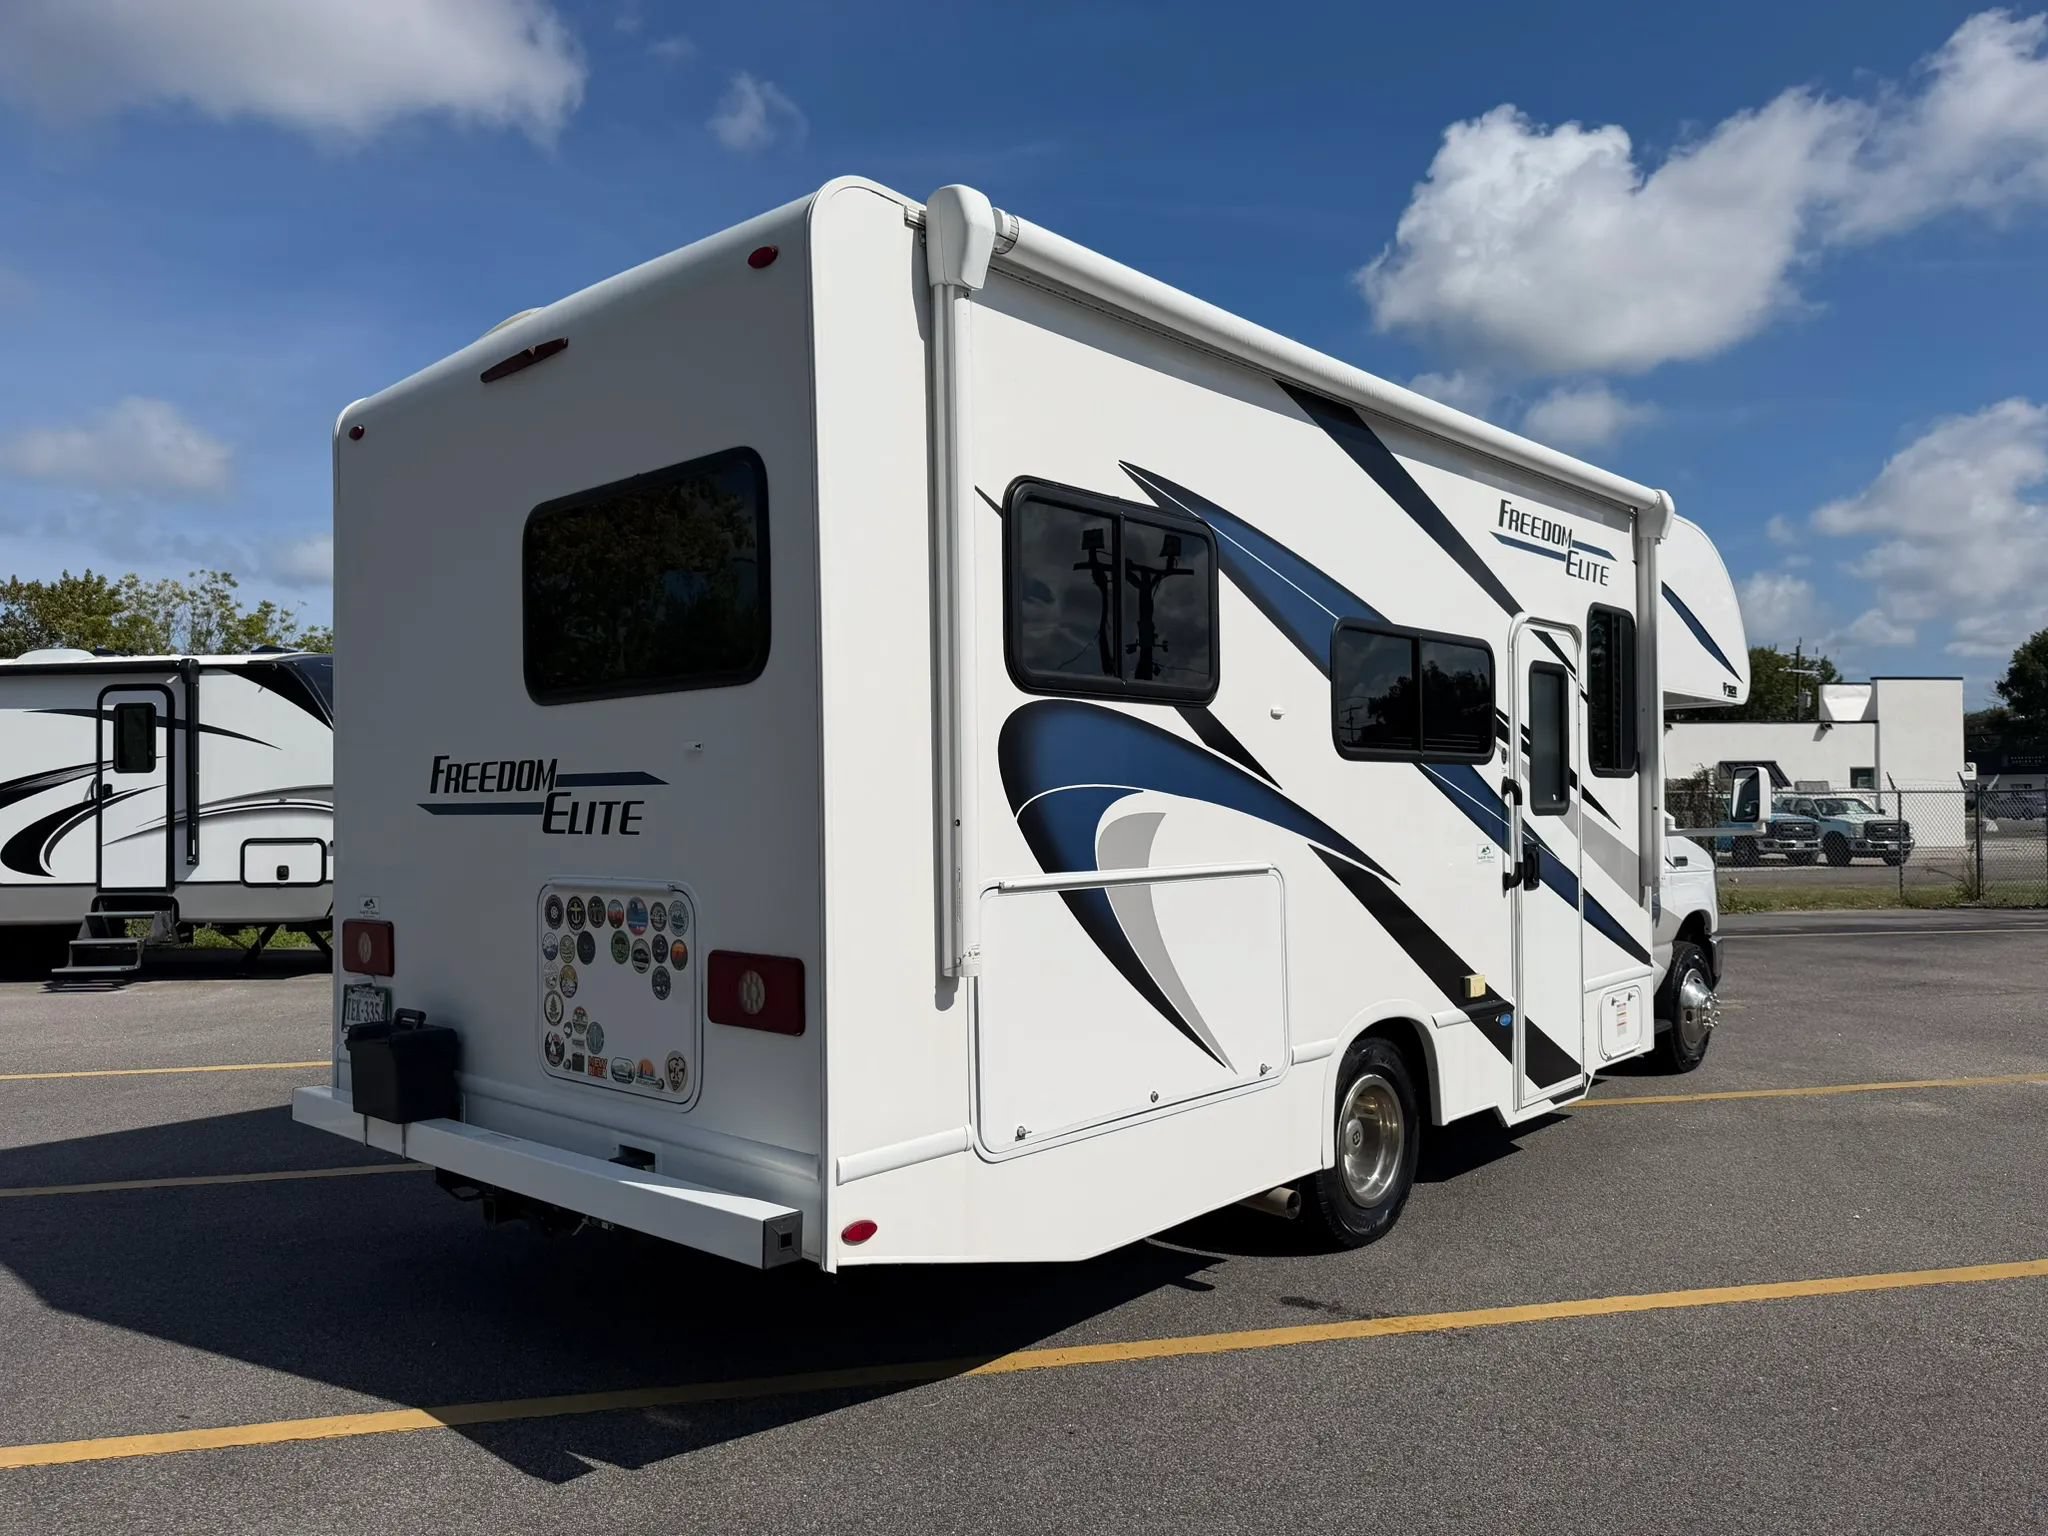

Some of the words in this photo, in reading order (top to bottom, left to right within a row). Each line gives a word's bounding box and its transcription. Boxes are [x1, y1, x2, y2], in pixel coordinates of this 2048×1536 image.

[1498, 499, 1573, 549] FREEDOM
[1565, 549, 1610, 586] ELITE
[430, 755, 558, 793] FREEDOM
[542, 791, 645, 835] ELITE
